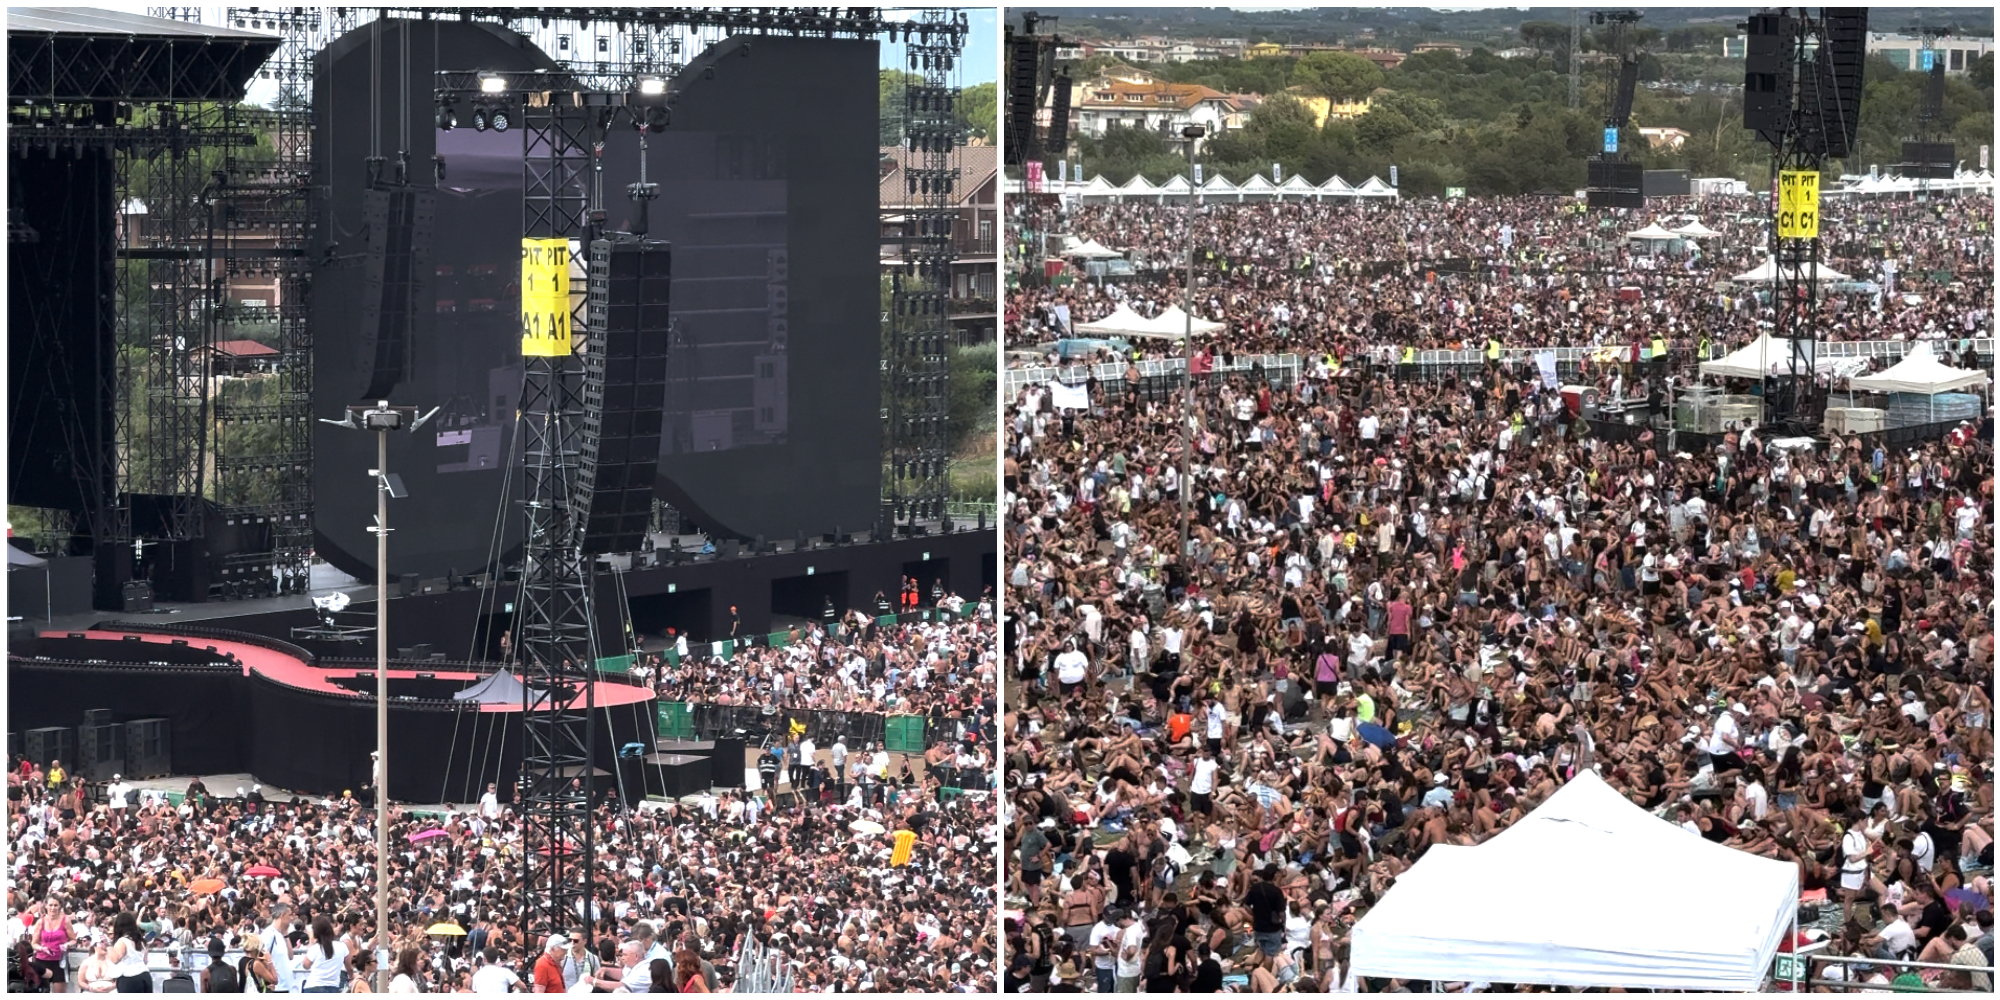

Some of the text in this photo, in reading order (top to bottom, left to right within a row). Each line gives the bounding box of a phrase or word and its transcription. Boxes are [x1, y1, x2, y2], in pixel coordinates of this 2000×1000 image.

[1782, 174, 1816, 186] PIT PIT
[1786, 190, 1810, 200] 1 1
[1781, 211, 1813, 228] C1 C1
[522, 246, 566, 265] PIT PIT
[528, 272, 558, 292] 1 1
[522, 311, 564, 340] A1 A1
